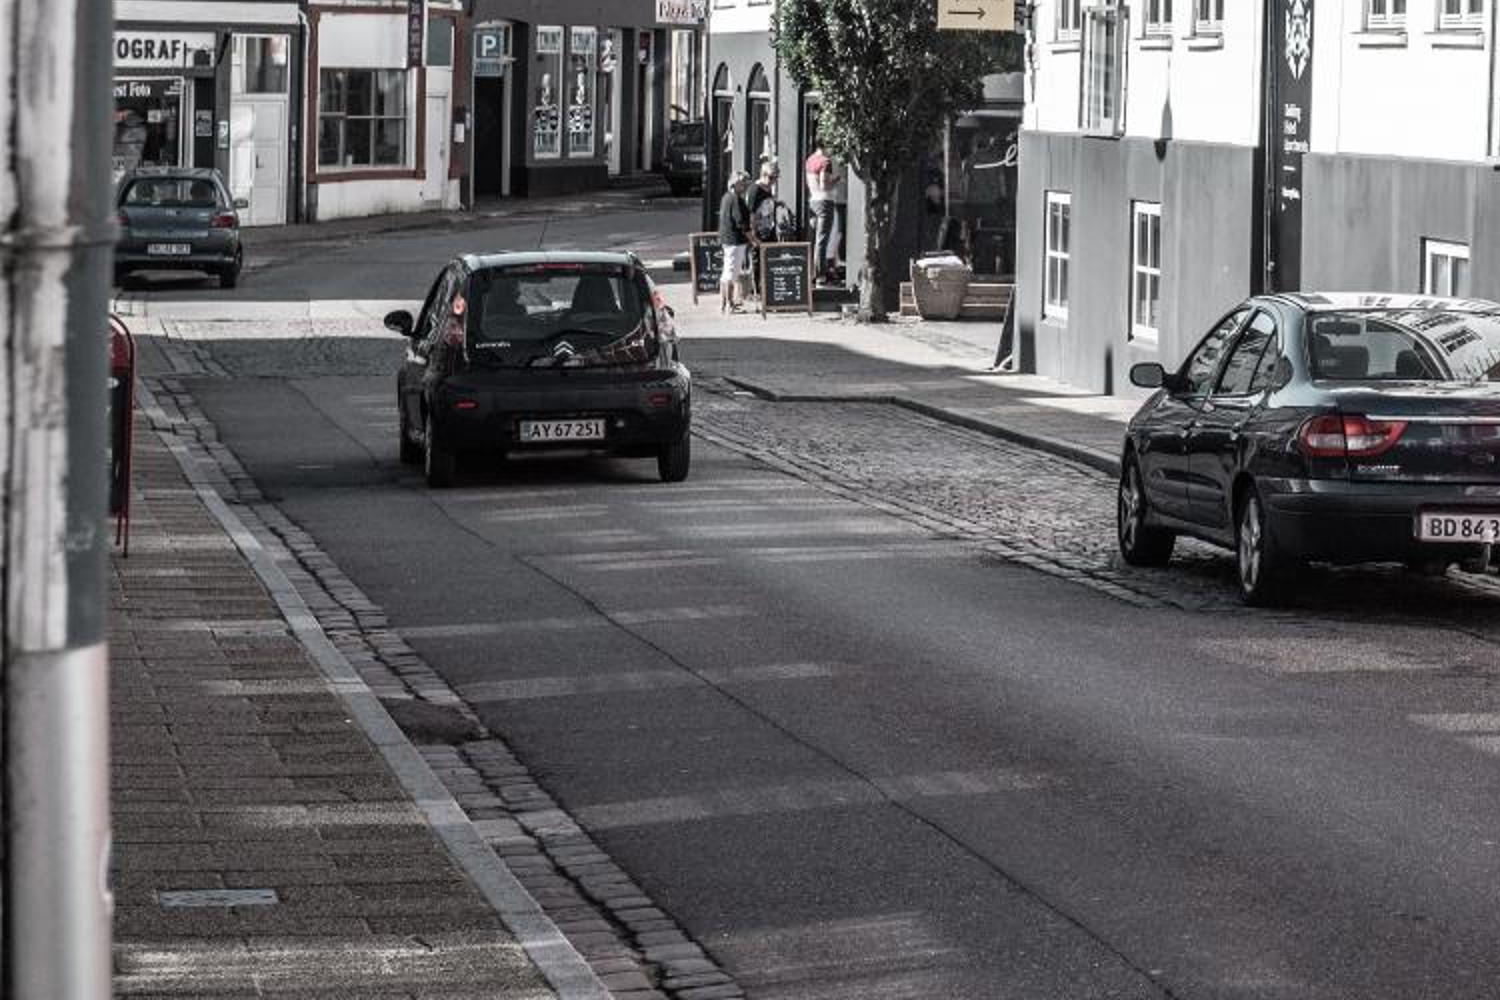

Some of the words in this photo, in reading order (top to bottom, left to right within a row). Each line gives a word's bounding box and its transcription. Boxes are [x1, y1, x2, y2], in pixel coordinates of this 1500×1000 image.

[481, 34, 497, 57] P
[531, 423, 551, 437] AY
[554, 423, 573, 437] 67
[575, 423, 600, 437] 251
[1430, 518, 1457, 537] BD
[1461, 519, 1485, 537] 84
